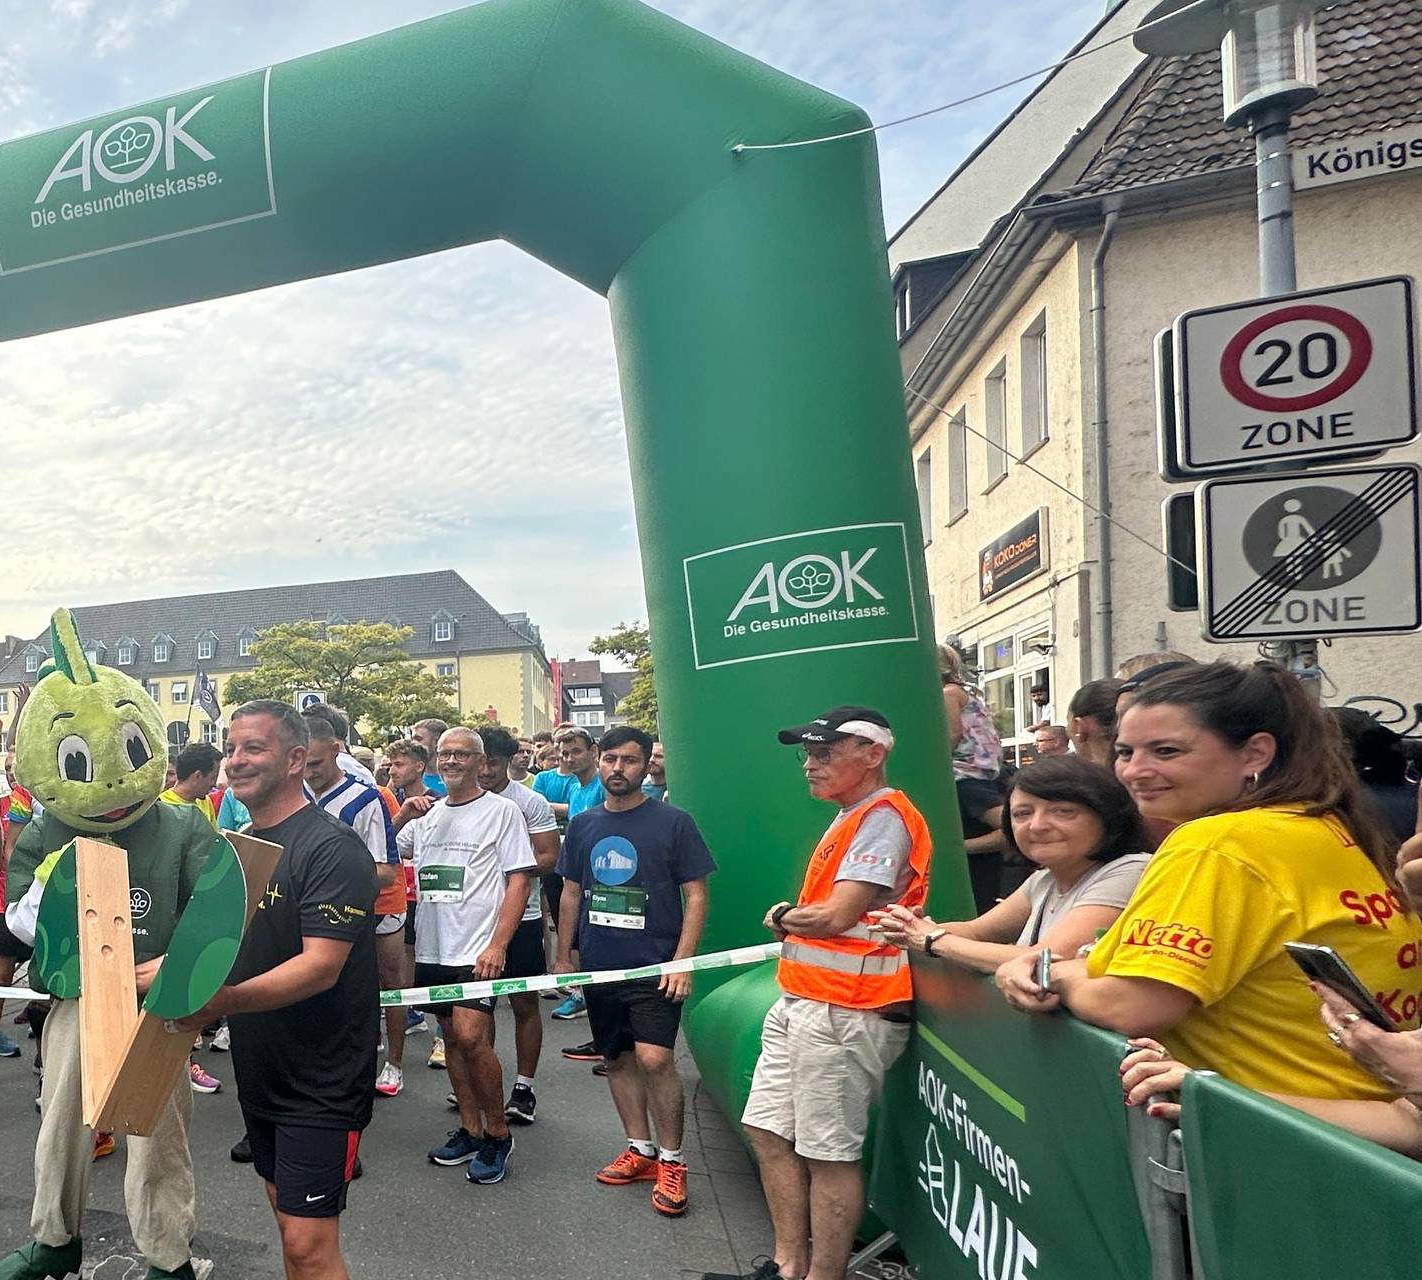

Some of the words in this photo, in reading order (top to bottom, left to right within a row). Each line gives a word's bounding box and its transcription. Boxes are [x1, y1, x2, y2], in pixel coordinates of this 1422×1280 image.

[34, 95, 216, 204] AOK
[30, 207, 57, 228] Die
[60, 170, 223, 221] Gesundheitskasse.
[1255, 331, 1338, 387] 20
[1241, 411, 1354, 450] ZONE
[726, 547, 885, 622] AOK
[1261, 596, 1365, 625] ZONE
[723, 624, 746, 638] Die
[749, 604, 890, 633] Gesundheitskasse.
[1340, 889, 1406, 930] Spo
[1122, 918, 1214, 960] Netto
[918, 1061, 1031, 1204] AOK-Firmen-
[949, 1160, 1038, 1280] LAUF
